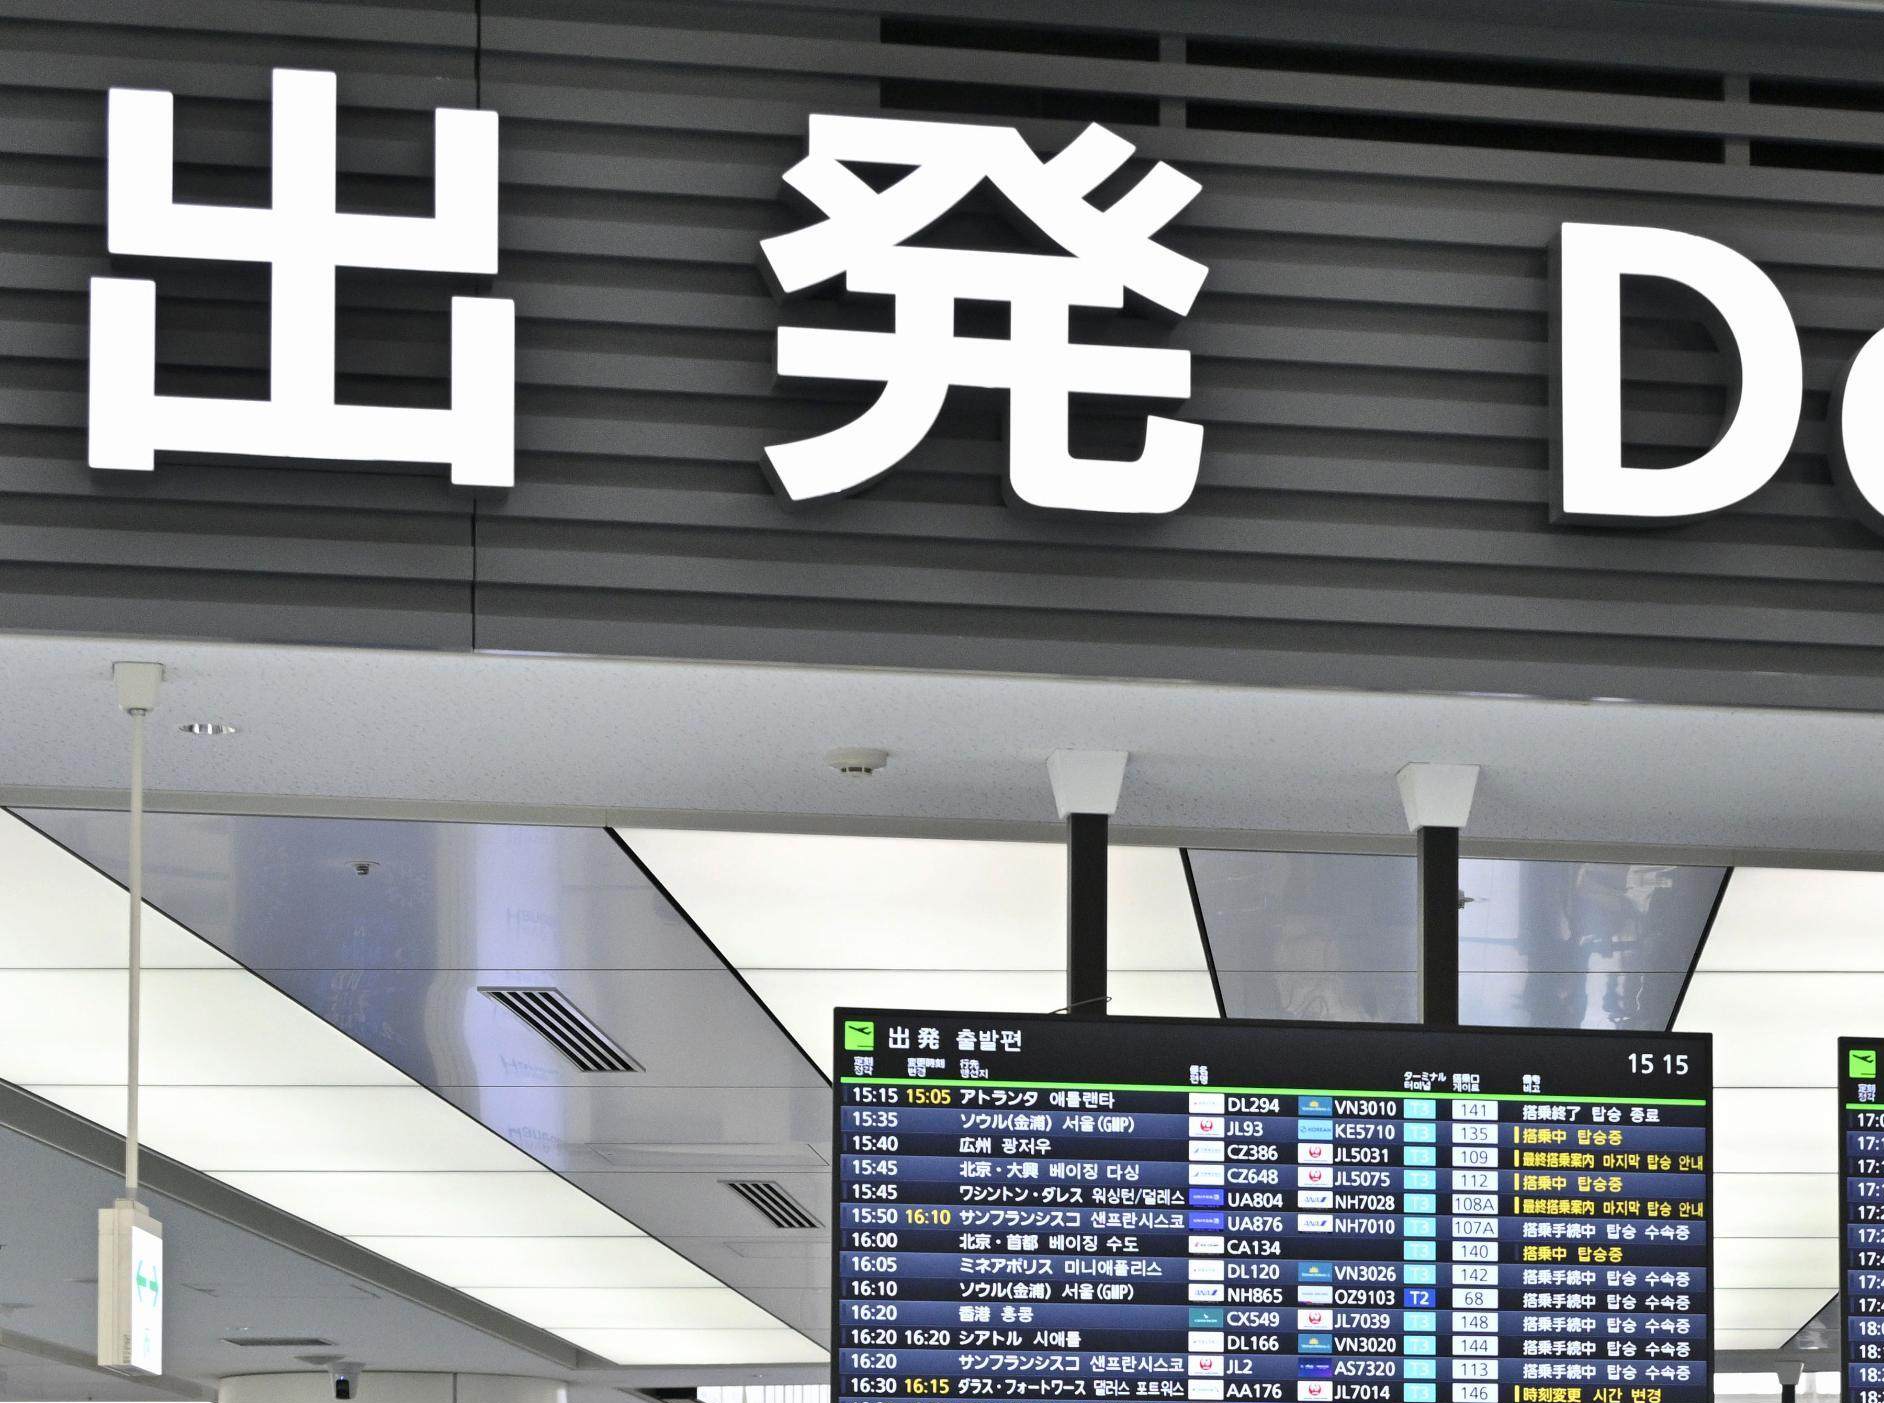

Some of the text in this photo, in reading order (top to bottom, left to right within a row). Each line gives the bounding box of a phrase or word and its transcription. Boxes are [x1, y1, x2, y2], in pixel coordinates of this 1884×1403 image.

[88, 68, 1209, 514] 出発
[888, 1026, 940, 1050] 出発
[955, 1028, 1022, 1052] 출발편
[1628, 1053, 1689, 1075] 15 15
[853, 1087, 1280, 1113] 15:15 15:05 アトランタ DL294
[1226, 1120, 1264, 1137] JL93
[1335, 1123, 1396, 1140] KE5710
[853, 1135, 1279, 1161] 15:40 広州 CZ386
[852, 1159, 898, 1176] 15:45
[1227, 1192, 1494, 1211] UA804 108A
[852, 1207, 1081, 1227] 15:50 16:10 サンフランシスコ
[851, 1255, 1280, 1280] 16:05 ミネアポリス DL120
[1409, 1291, 1430, 1306] T2
[851, 1304, 1280, 1327] 16:20 홍콩 CX549
[959, 1330, 1023, 1346] シアトル
[851, 1352, 1396, 1377] 16:20 AS7320
[905, 1378, 950, 1394] 16:15
[1226, 1383, 1283, 1399] AA176
